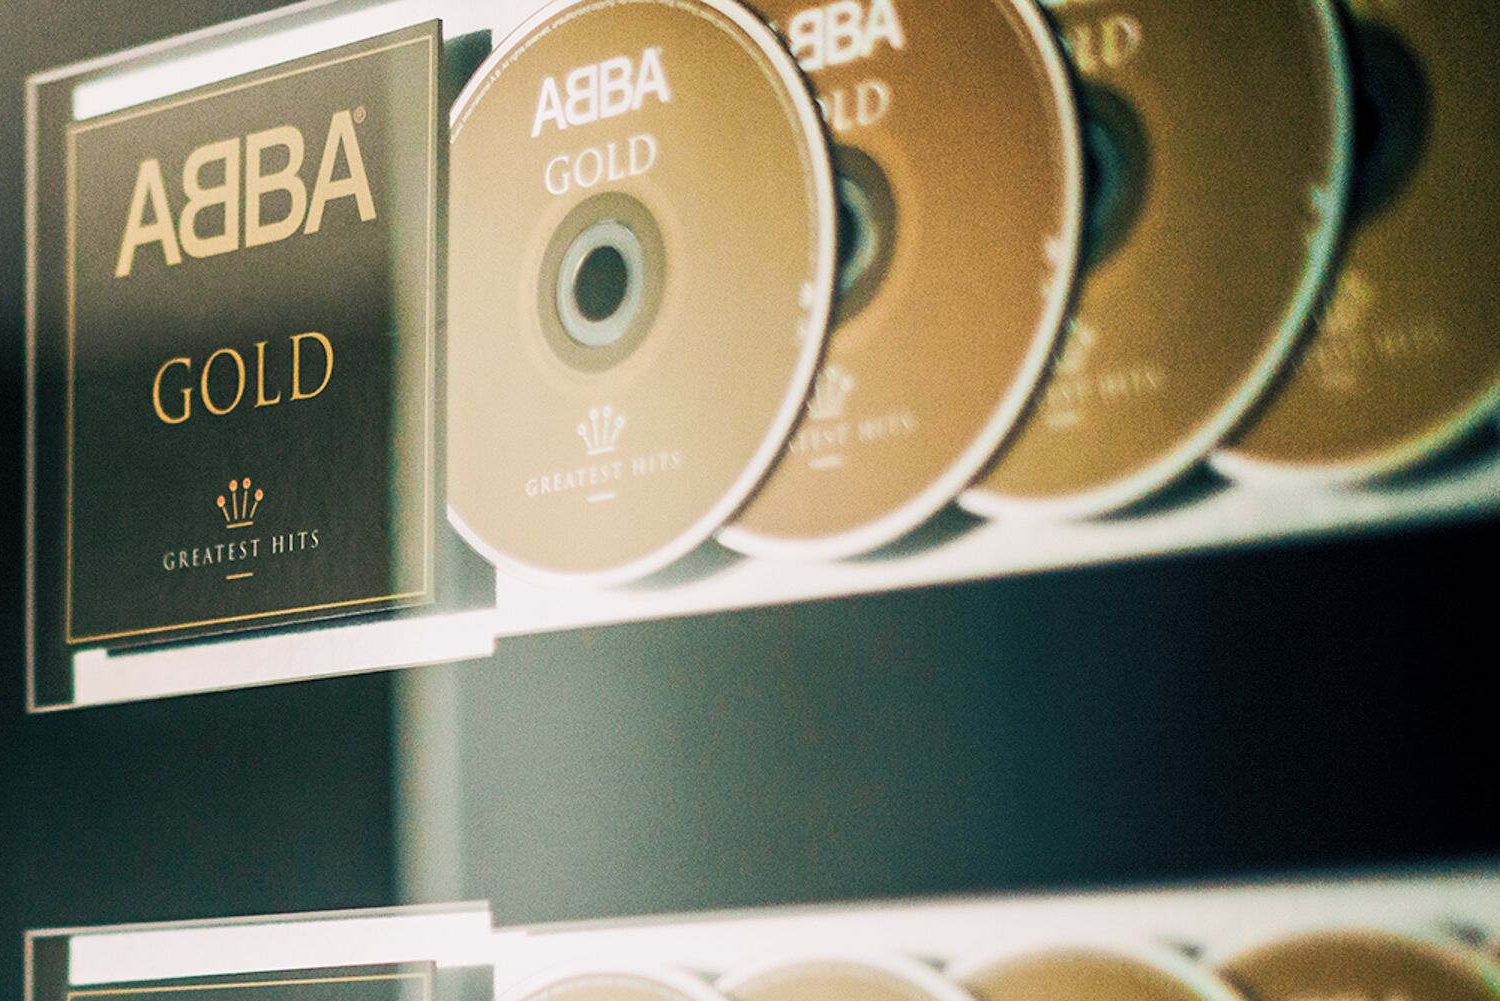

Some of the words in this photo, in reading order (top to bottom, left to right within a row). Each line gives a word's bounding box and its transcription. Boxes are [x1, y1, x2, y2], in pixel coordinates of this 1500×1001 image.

[787, 0, 905, 72] BBA
[531, 47, 672, 138] ABBA
[815, 80, 890, 132] LD
[543, 133, 657, 196] GOLD
[152, 330, 335, 425] GOLD
[525, 459, 623, 497] GREATEST
[631, 451, 683, 477] HITS
[163, 538, 260, 571] GREATEST
[272, 529, 320, 555] HITS
